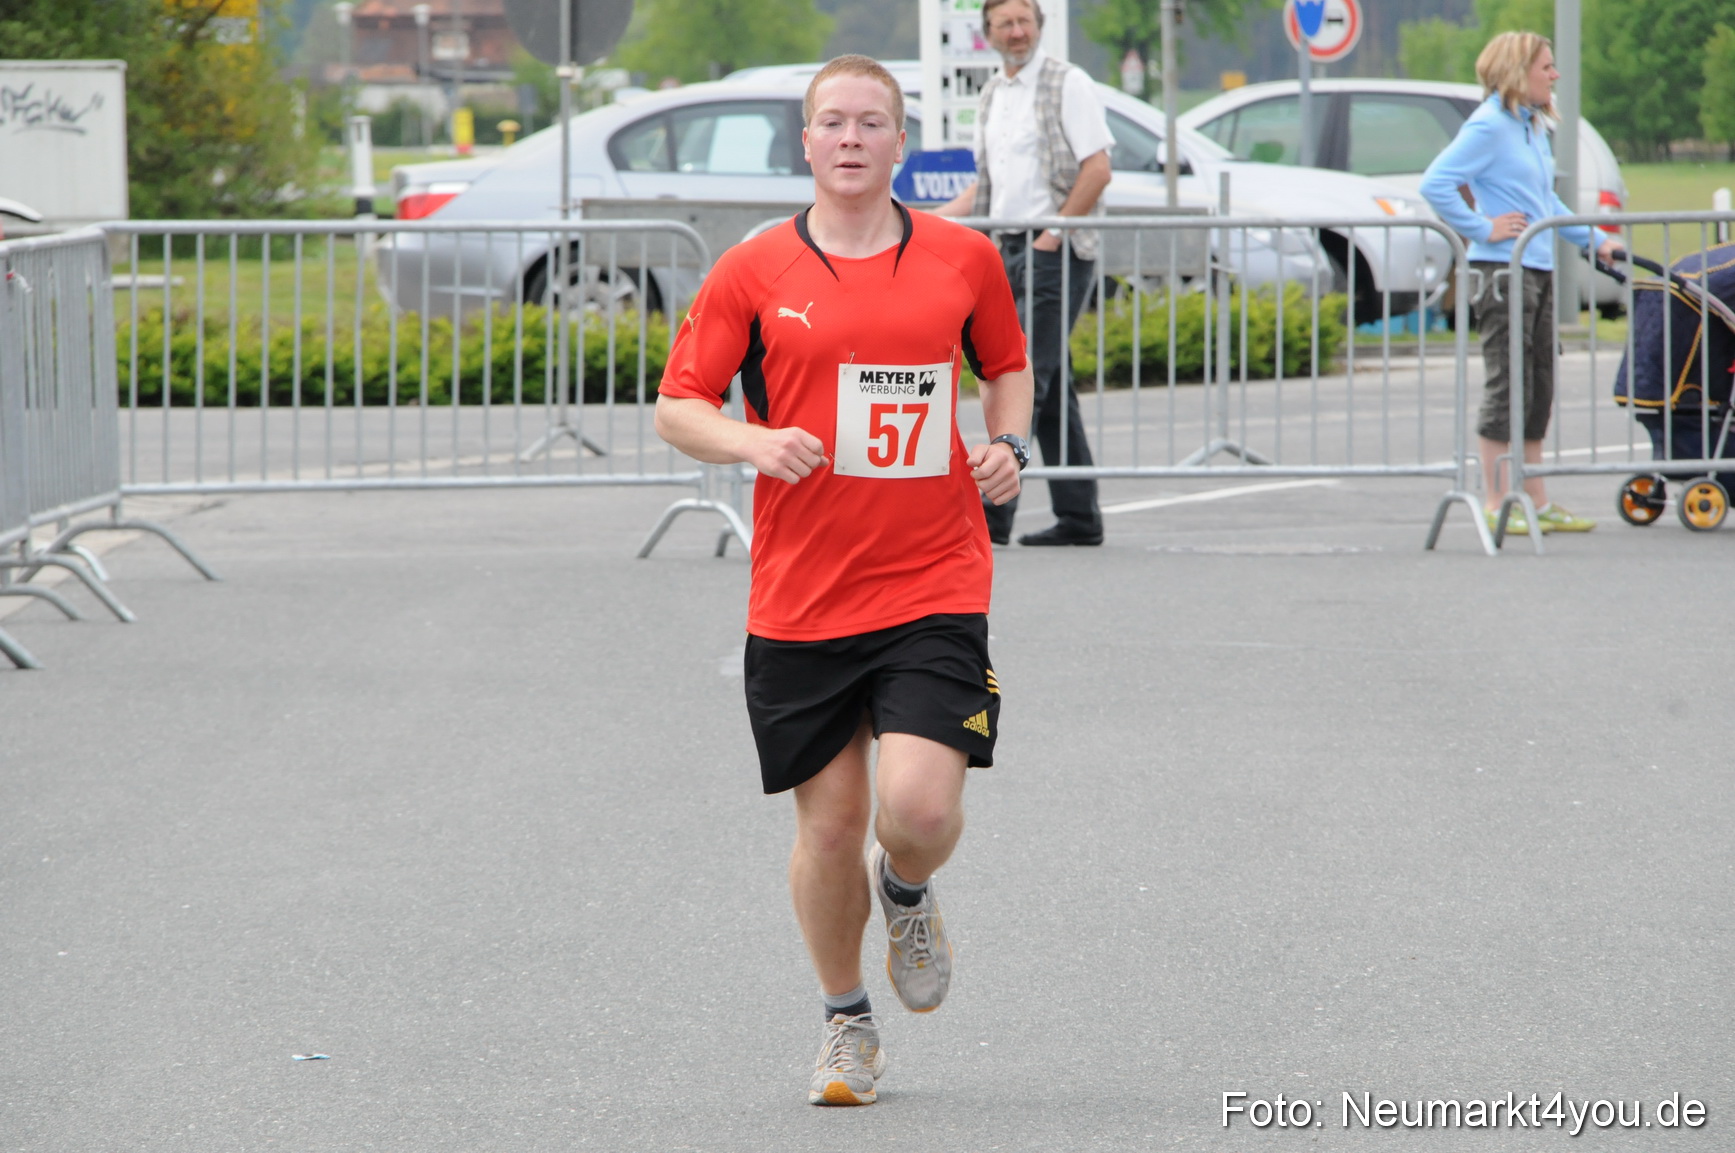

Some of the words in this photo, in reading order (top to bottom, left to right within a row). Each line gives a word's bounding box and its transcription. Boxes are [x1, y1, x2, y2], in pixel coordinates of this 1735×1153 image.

[859, 370, 916, 384] MEYER
[859, 384, 916, 395] WERBUNG
[867, 403, 929, 468] 57
[962, 719, 990, 738] adidas
